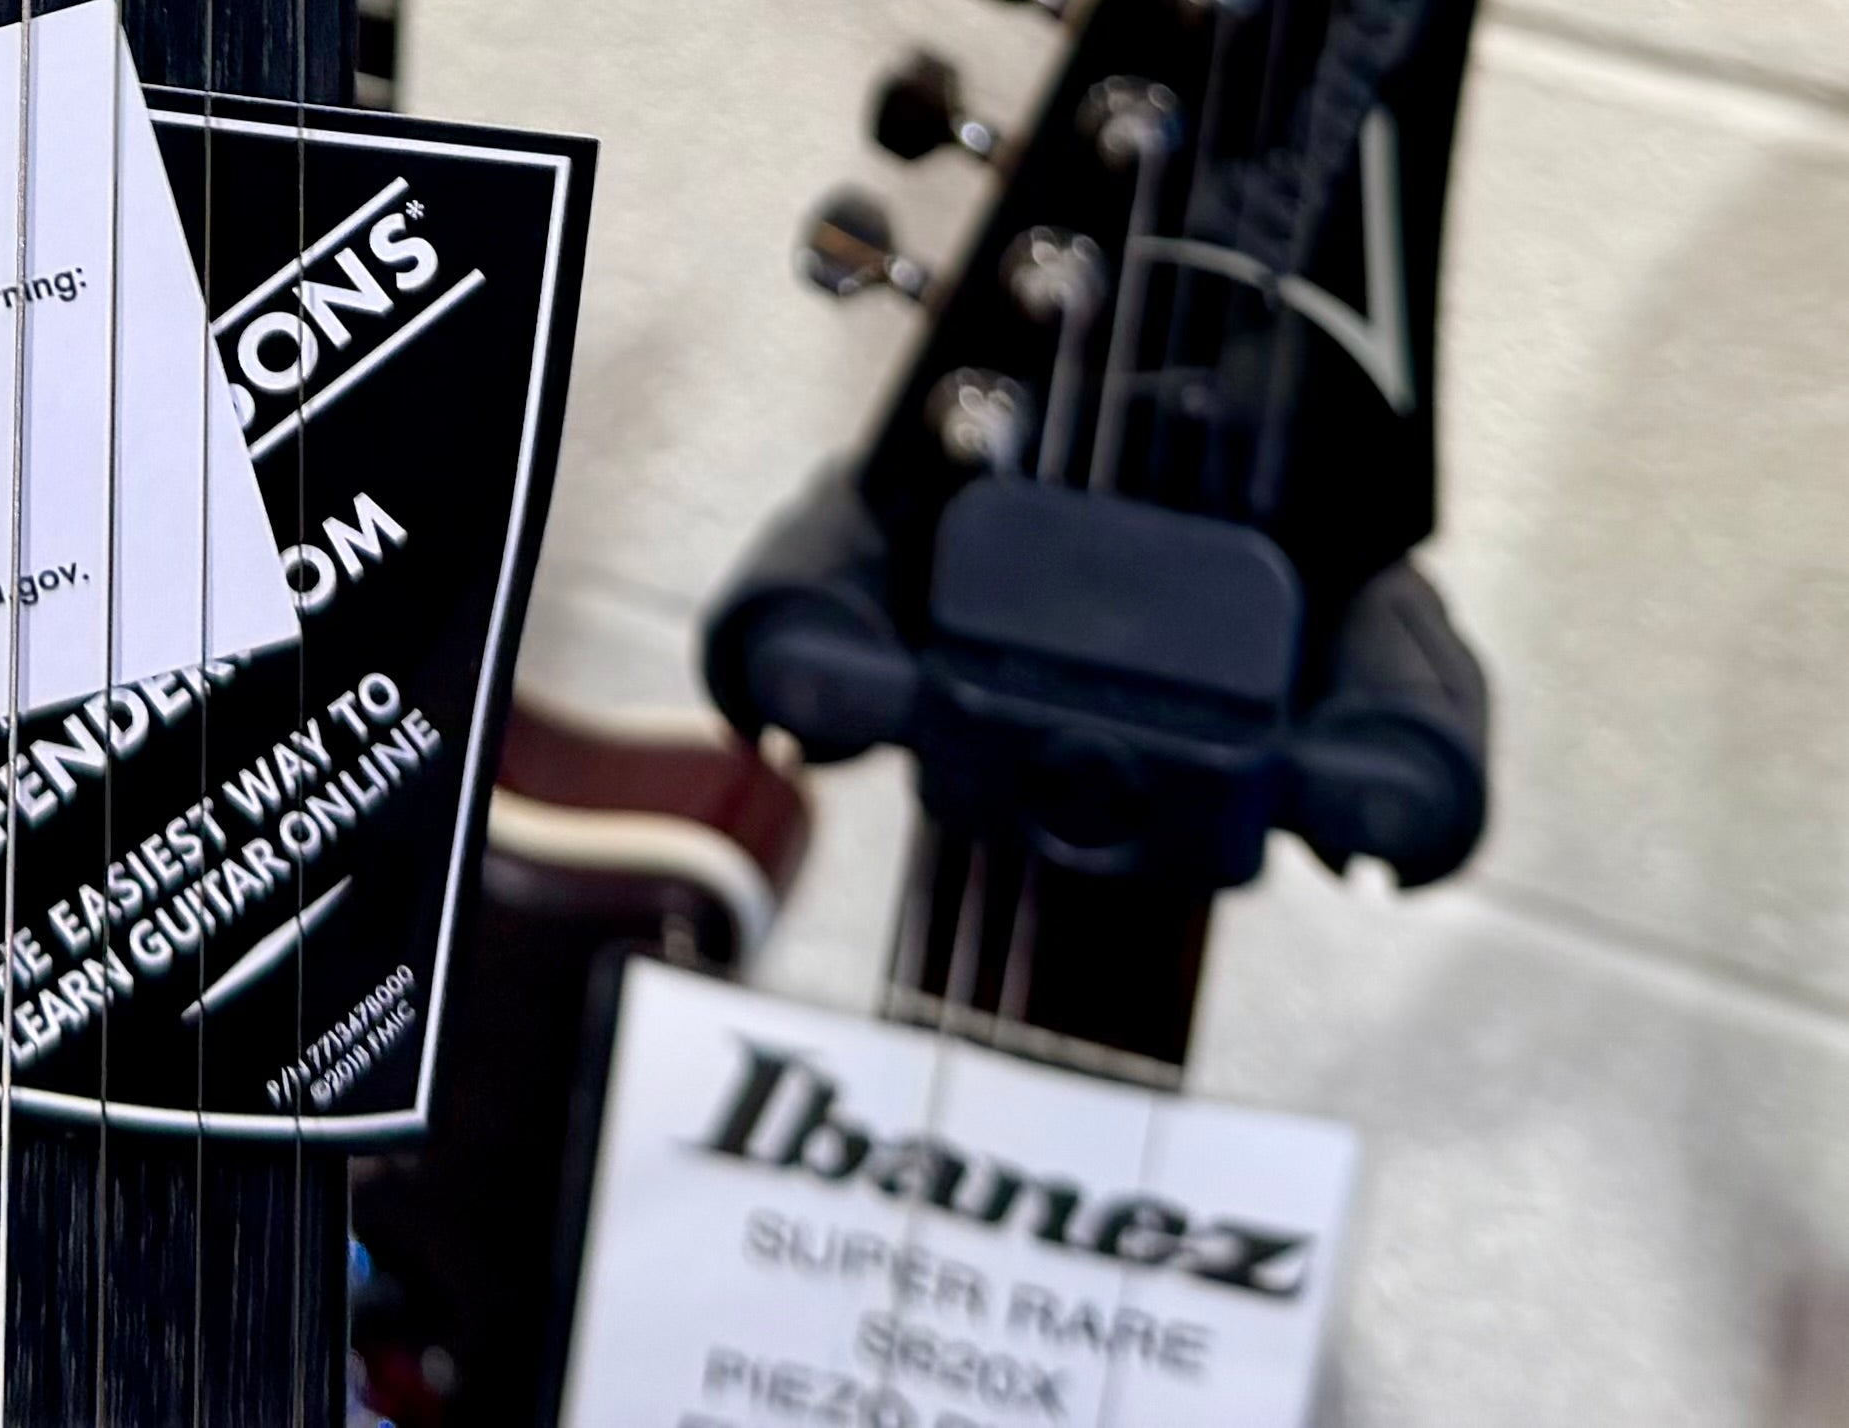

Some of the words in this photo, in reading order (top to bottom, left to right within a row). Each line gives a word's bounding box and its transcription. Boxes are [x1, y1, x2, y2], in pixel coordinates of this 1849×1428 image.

[48, 797, 228, 957] EASIEST
[222, 718, 332, 824] WAY
[327, 672, 402, 741] TO
[128, 837, 291, 976] GUITAR
[279, 708, 442, 862] ONLINE
[682, 1030, 1318, 1306] Ibanez
[744, 1204, 990, 1325] SUPER
[1005, 1276, 1210, 1382] RARE
